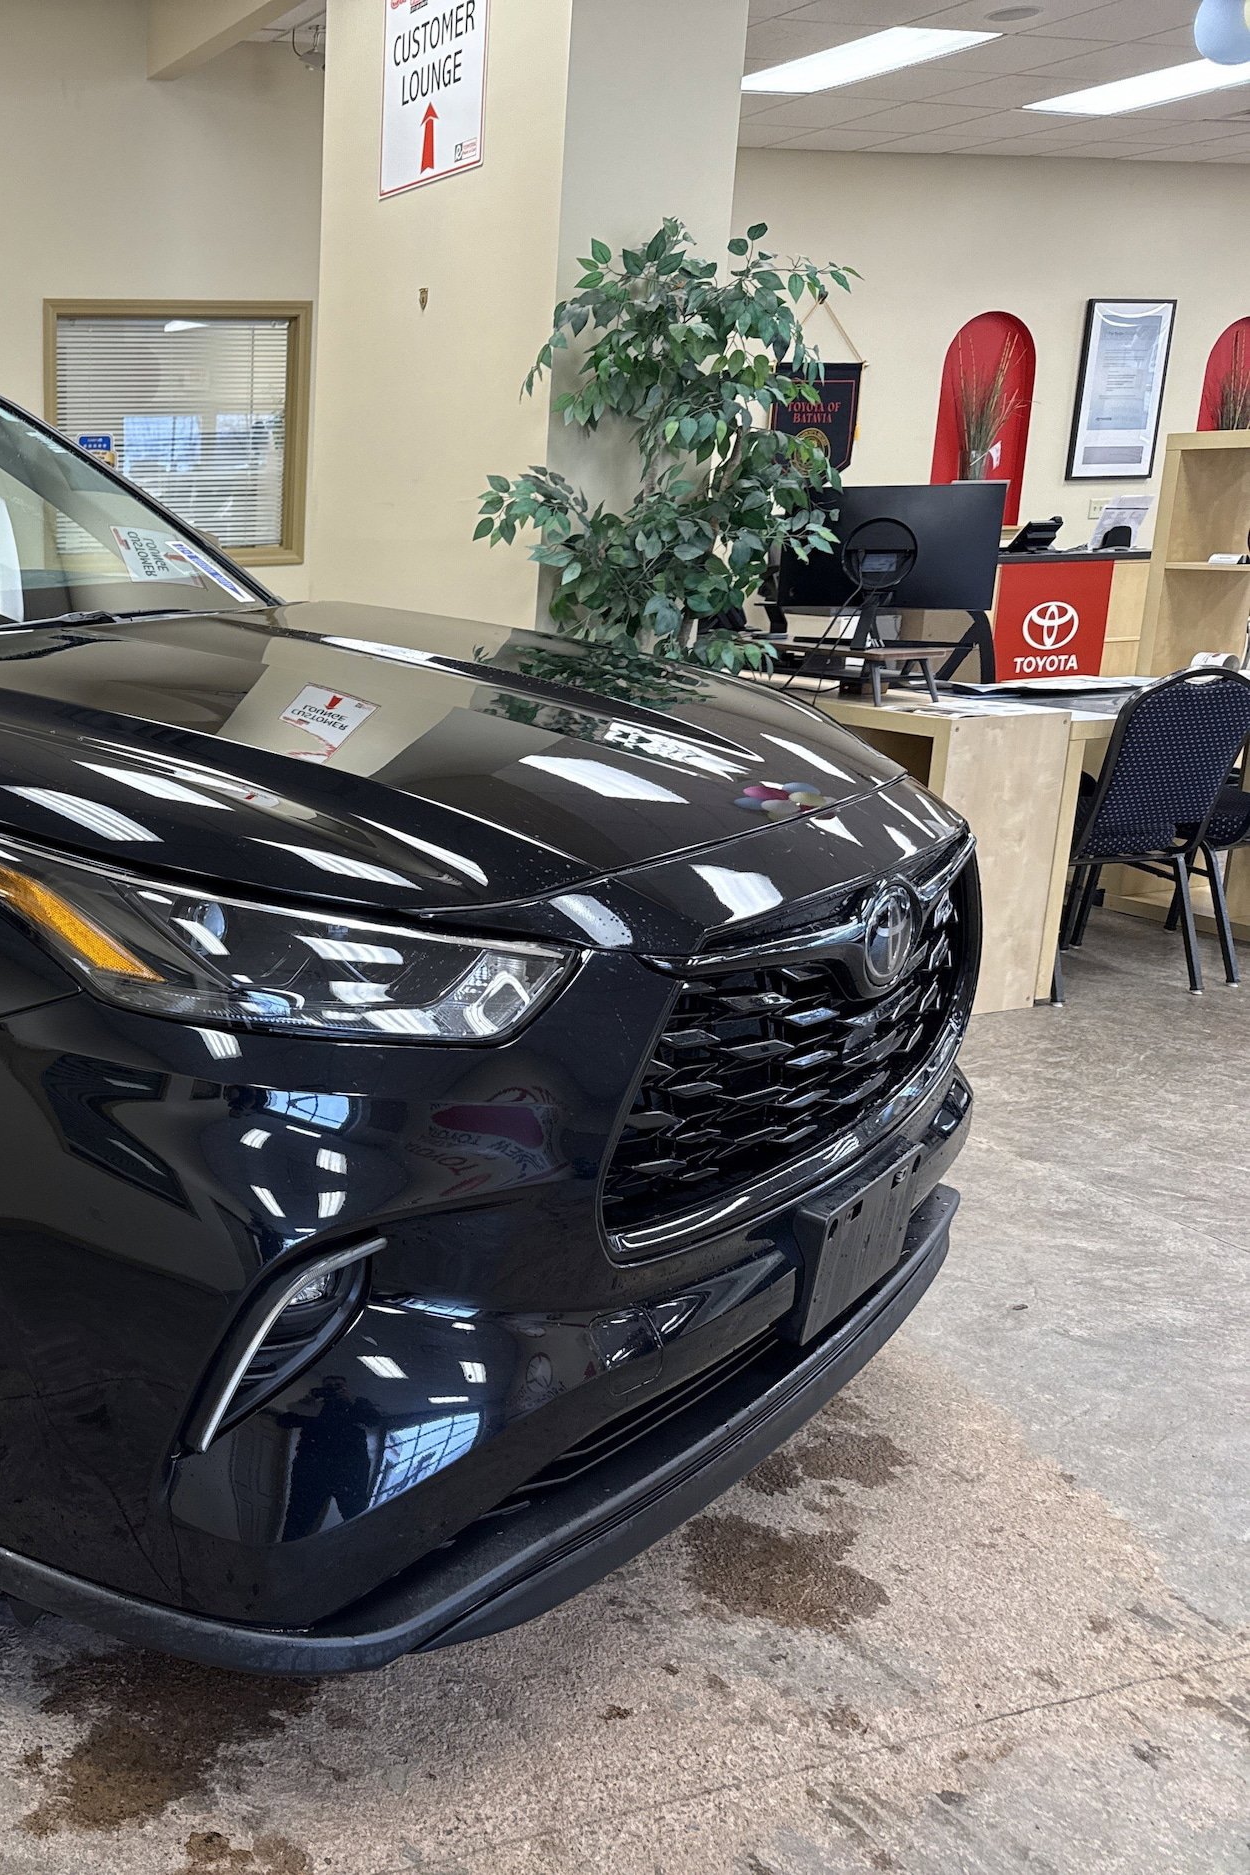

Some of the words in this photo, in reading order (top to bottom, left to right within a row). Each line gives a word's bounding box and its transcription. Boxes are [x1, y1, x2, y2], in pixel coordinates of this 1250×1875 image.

[393, 0, 476, 67] CUSTOMER
[401, 49, 463, 107] LOUNGE
[827, 401, 842, 413] OF
[792, 412, 832, 424] BATAVIA
[1013, 654, 1079, 674] TOYOTA
